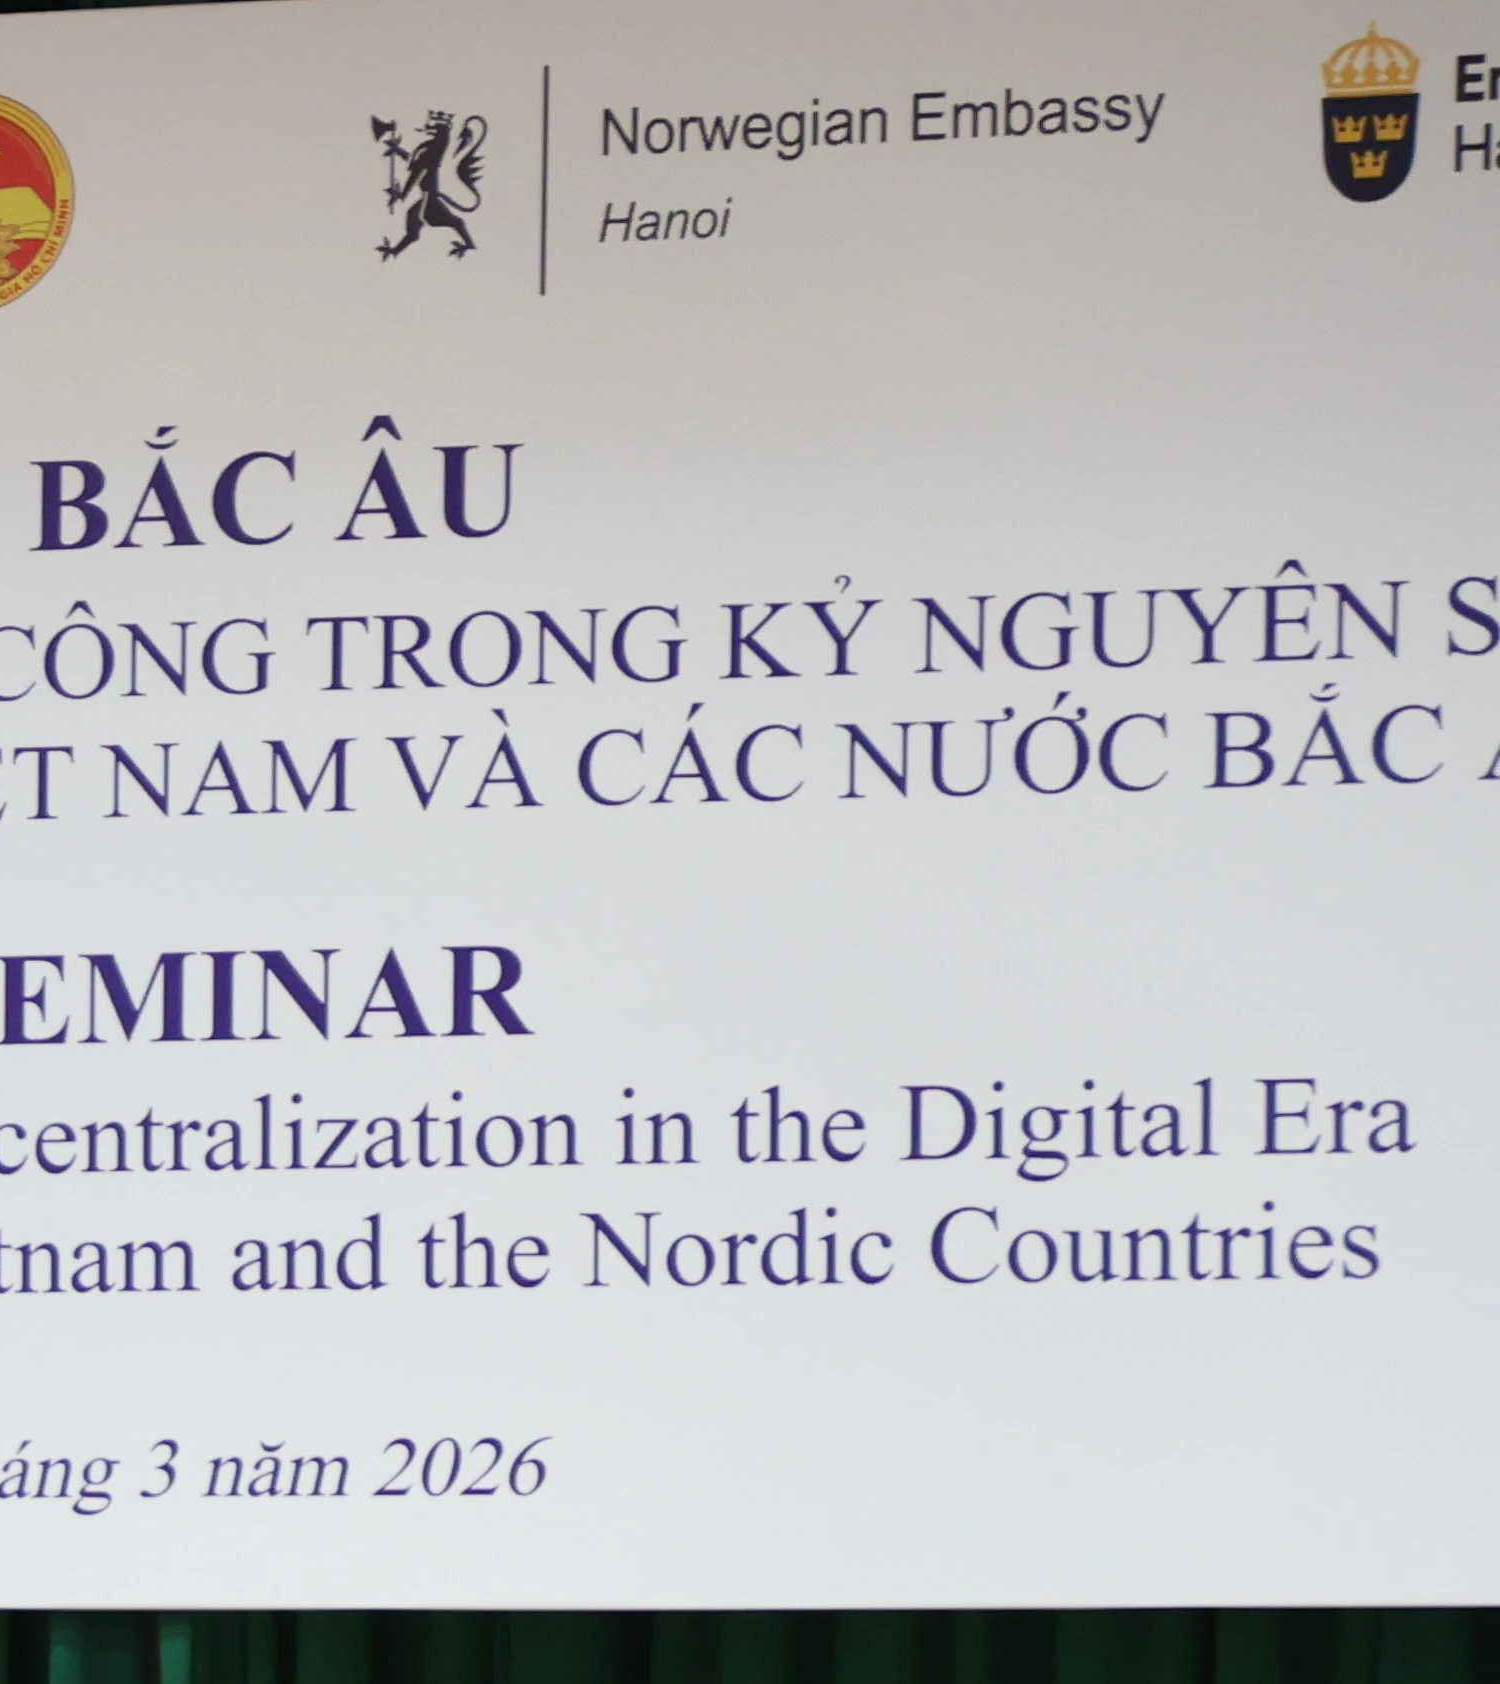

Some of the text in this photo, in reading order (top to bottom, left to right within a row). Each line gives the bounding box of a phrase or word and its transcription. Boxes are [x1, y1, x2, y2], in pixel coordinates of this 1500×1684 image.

[600, 86, 1167, 163] Norwegian Embassy
[597, 195, 734, 245] Hanoi
[28, 424, 297, 553] BẮC
[333, 413, 525, 542] ÂU
[305, 604, 689, 692] TRONG
[719, 574, 883, 681] KỶ
[911, 557, 1410, 675] NGUYÊN
[99, 737, 356, 819] NAM
[384, 707, 544, 812] VÀ
[576, 701, 804, 808] CÁC
[835, 689, 1168, 800] NƯỚC
[1204, 681, 1443, 790] BẮC
[615, 1086, 699, 1166] in
[729, 1084, 867, 1165] the
[899, 1076, 1219, 1184] Digital
[1254, 1076, 1417, 1156] Era
[230, 1212, 388, 1293] and
[417, 1210, 551, 1290] the
[579, 1205, 894, 1288] Nordic
[929, 1199, 1381, 1286] Countries
[138, 1438, 180, 1499] 3
[202, 1441, 350, 1499] năm
[372, 1435, 551, 1498] 2026
